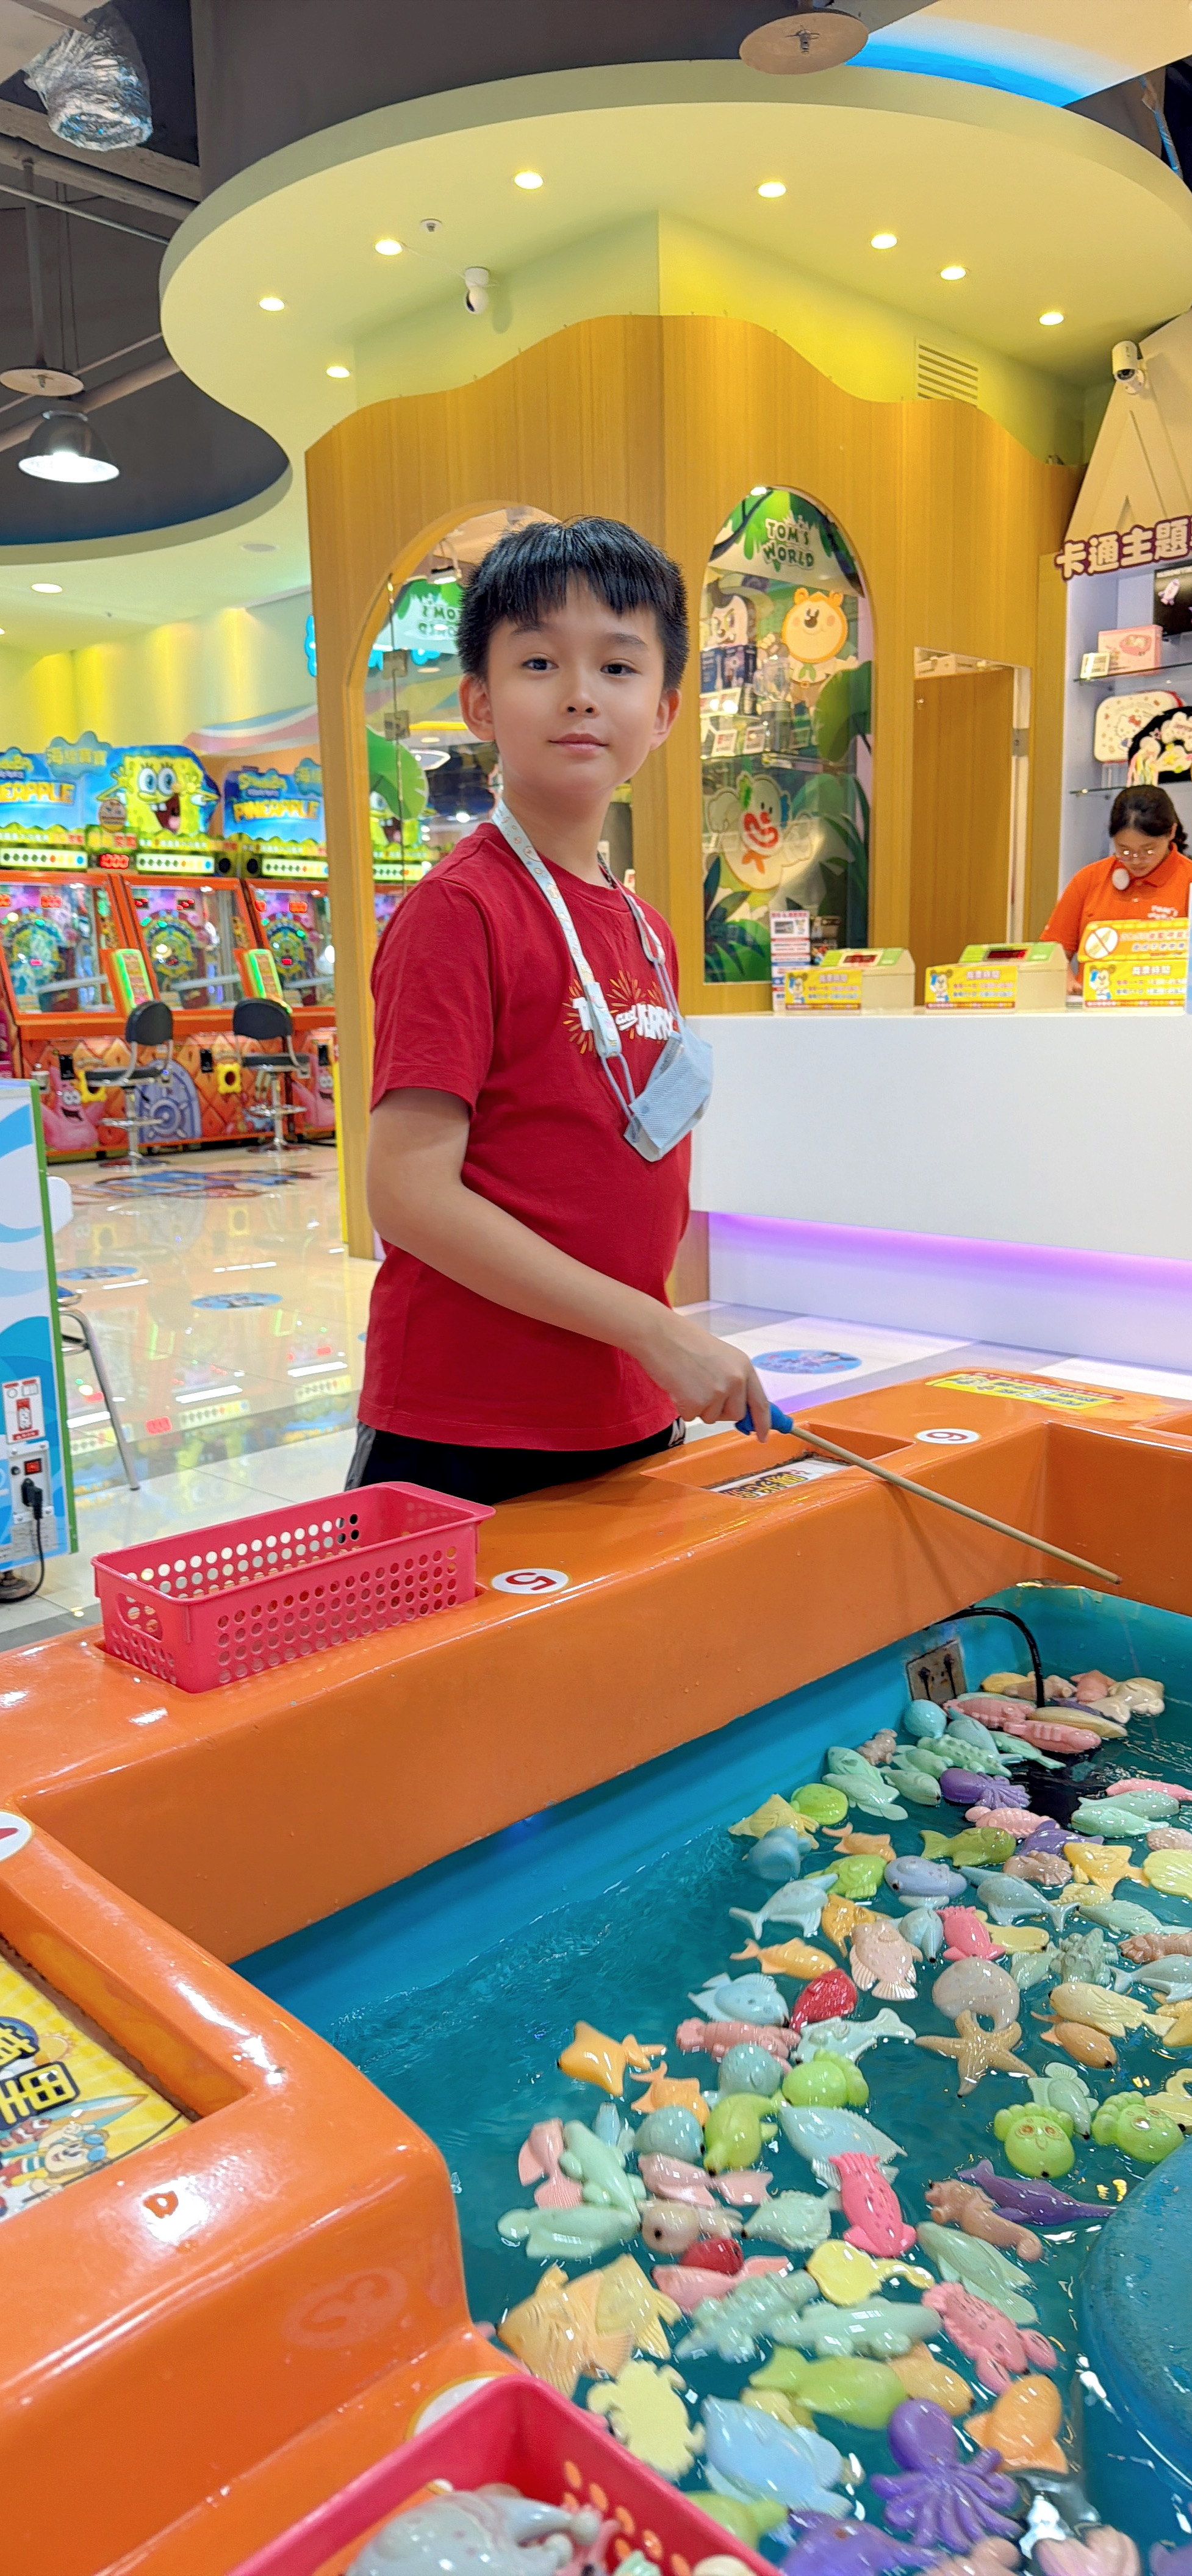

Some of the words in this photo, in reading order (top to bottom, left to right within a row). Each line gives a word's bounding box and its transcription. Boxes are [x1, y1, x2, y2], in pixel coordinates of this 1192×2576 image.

[763, 542, 814, 567] WORLD
[1055, 518, 1192, 579] 卡通主題
[505, 1572, 557, 1591] 5
